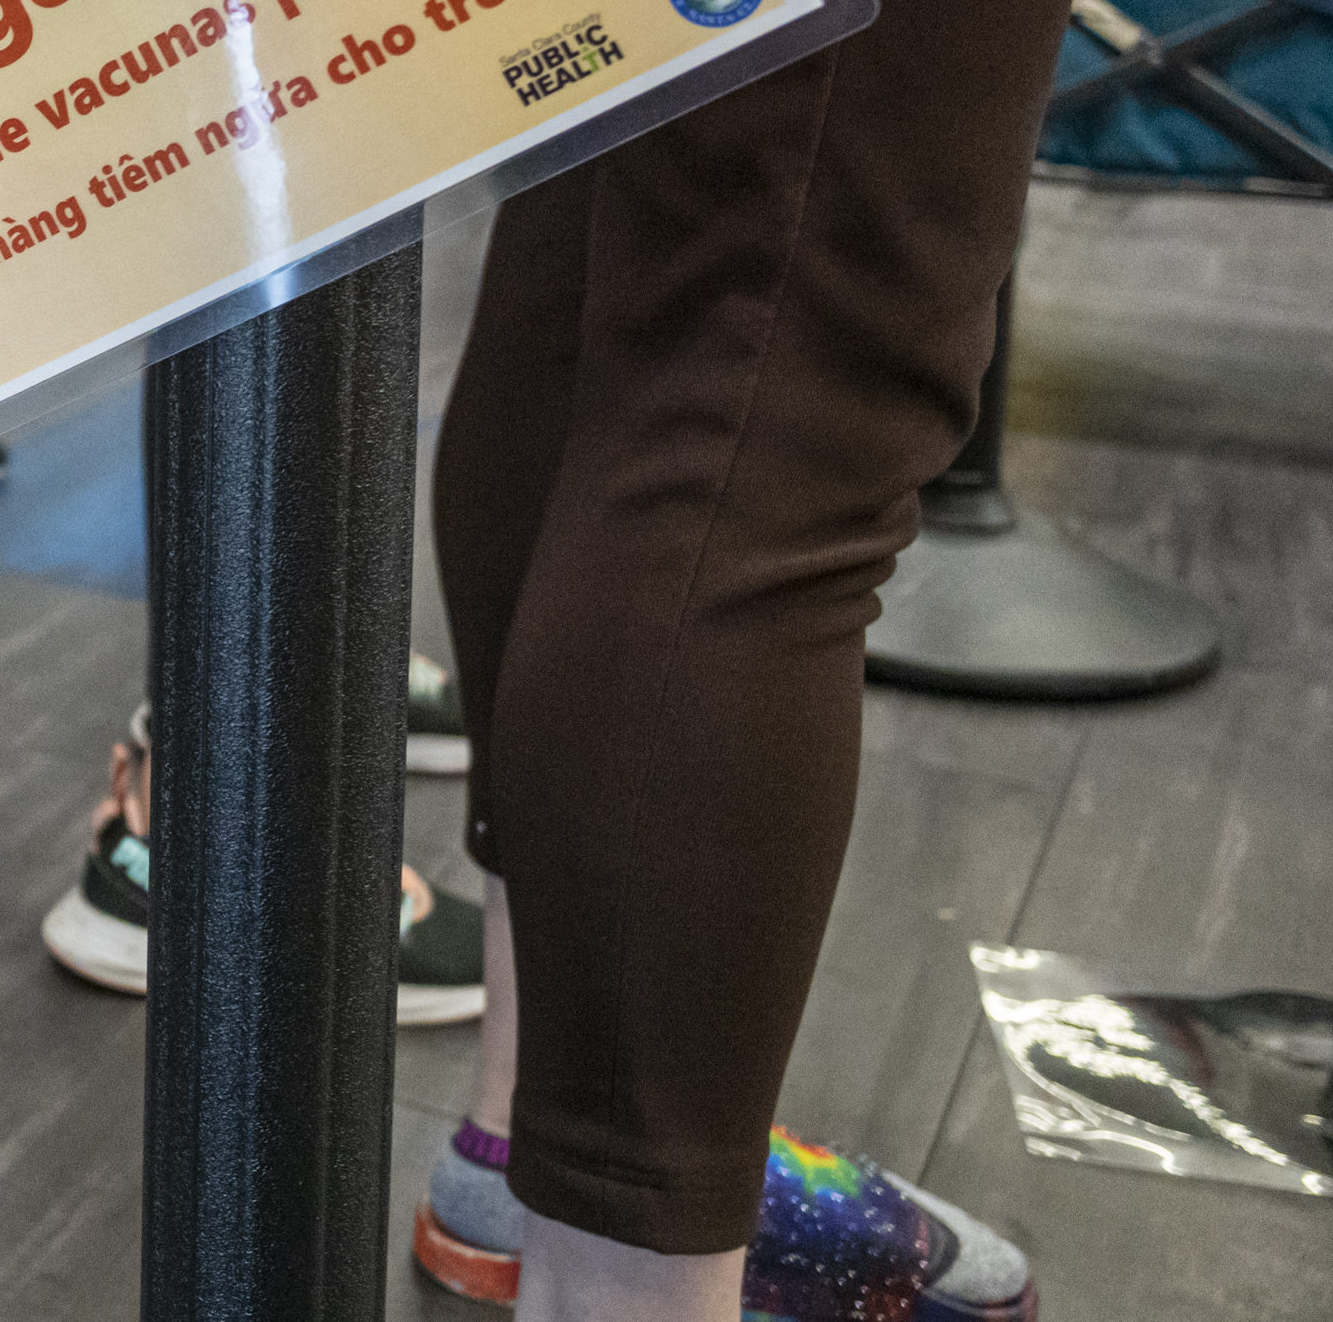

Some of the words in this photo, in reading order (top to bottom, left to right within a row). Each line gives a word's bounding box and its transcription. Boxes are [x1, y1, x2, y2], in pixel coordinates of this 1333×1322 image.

[502, 24, 609, 89] PUBLIC
[516, 40, 624, 107] HEALTH
[87, 141, 191, 209] tiêm
[326, 23, 416, 86] cho
